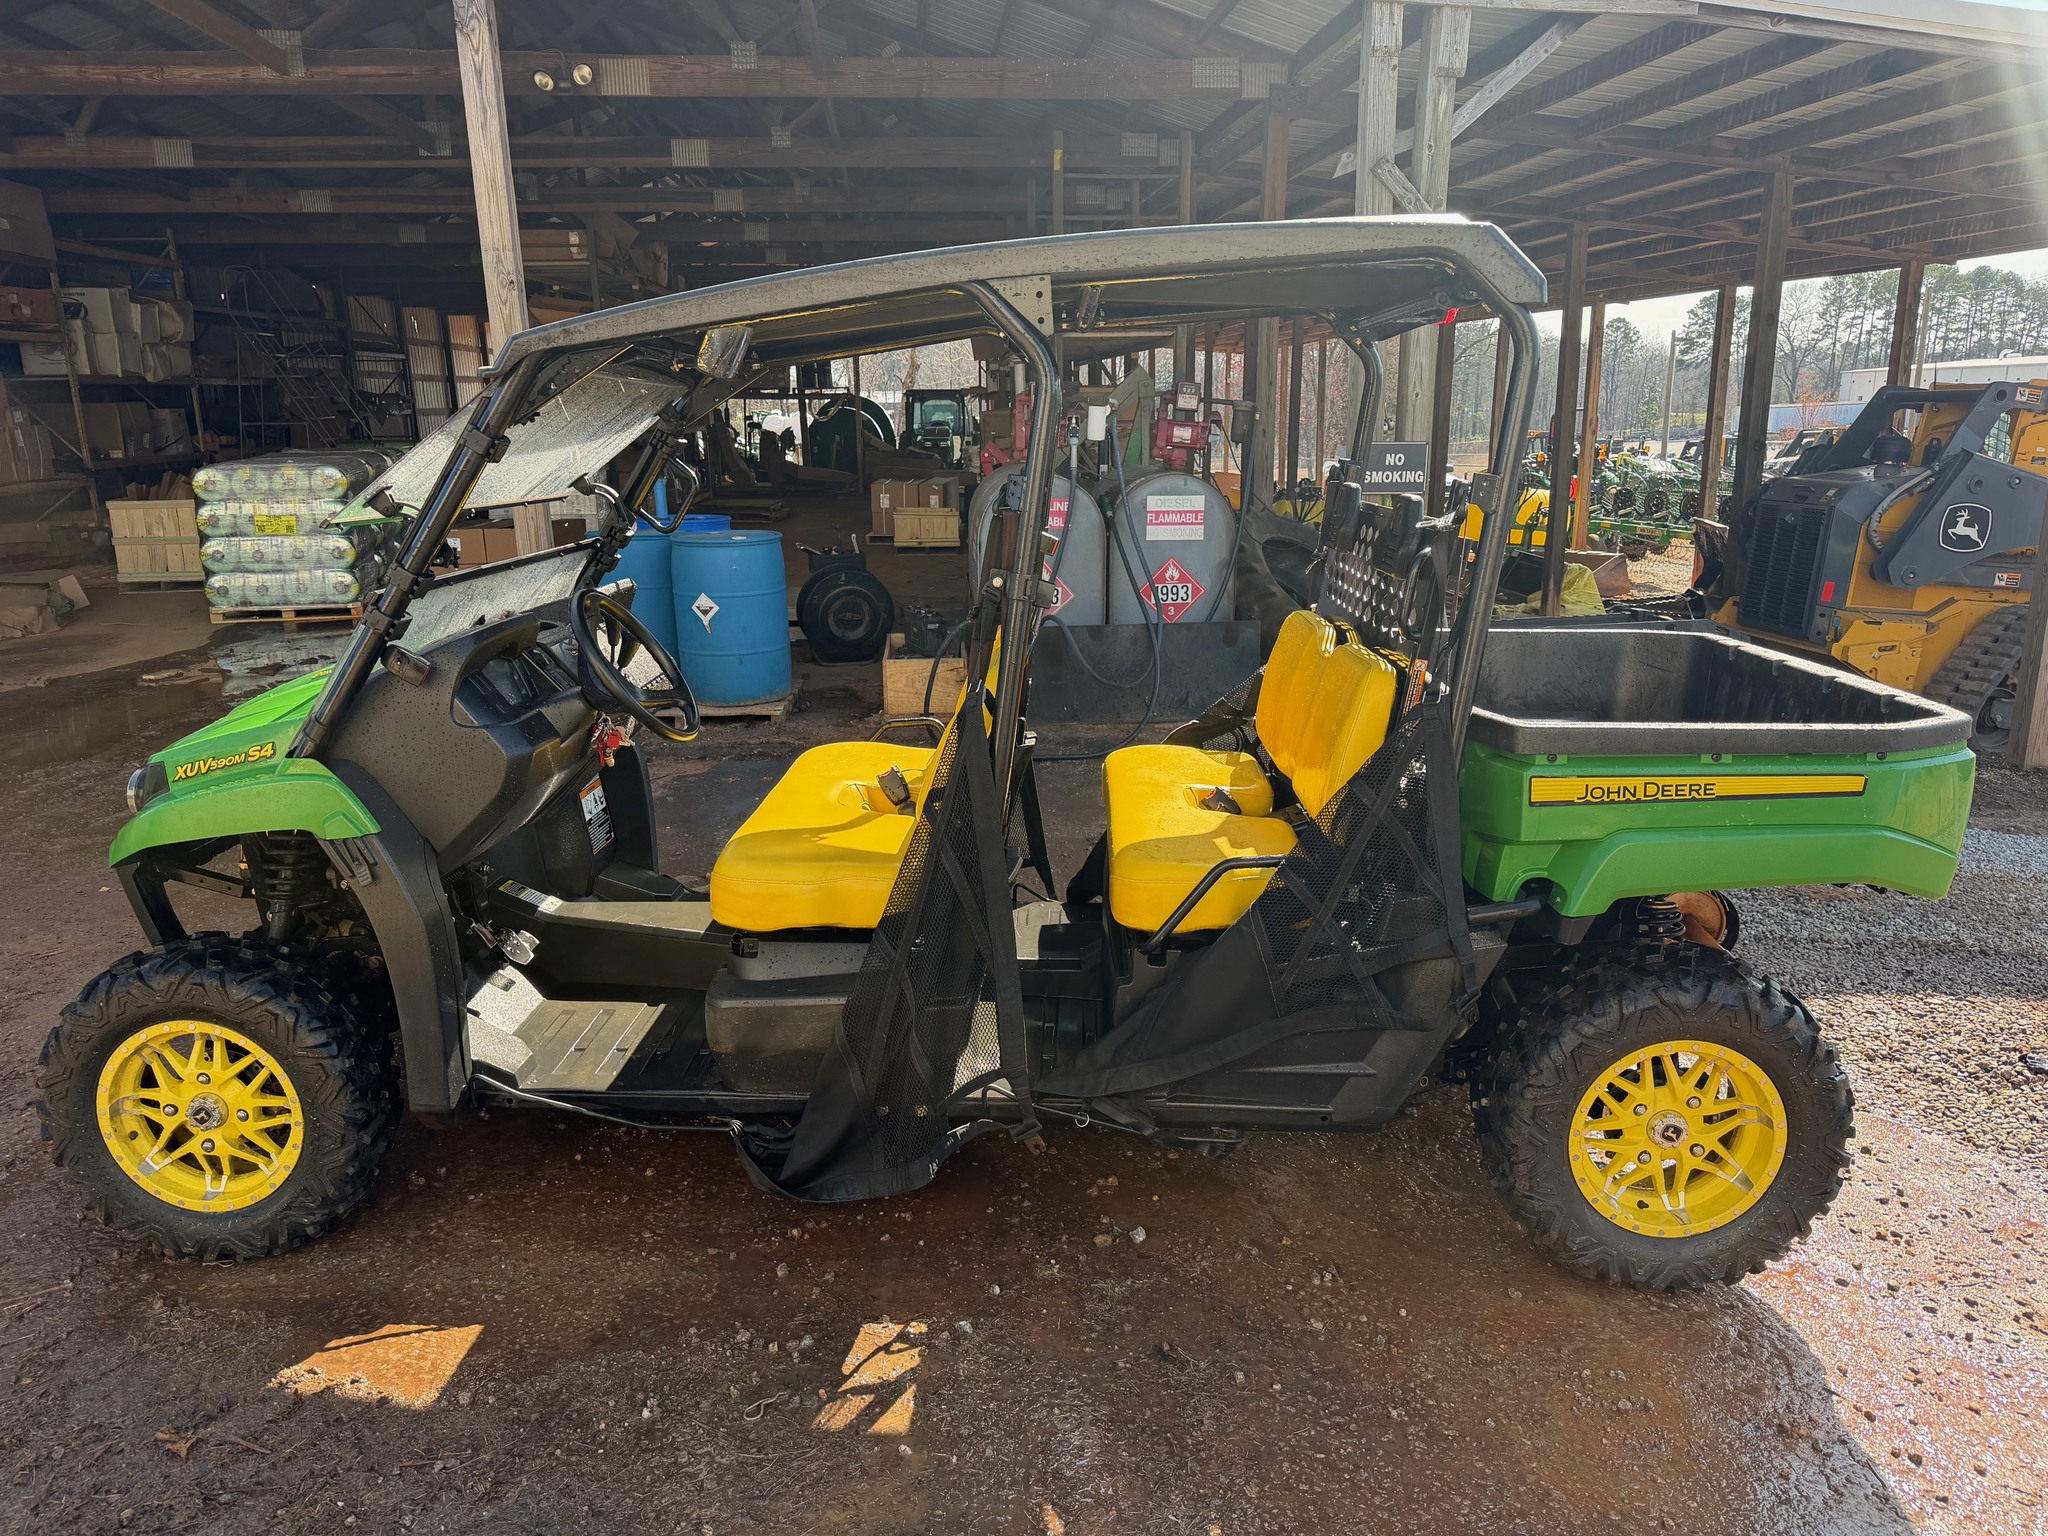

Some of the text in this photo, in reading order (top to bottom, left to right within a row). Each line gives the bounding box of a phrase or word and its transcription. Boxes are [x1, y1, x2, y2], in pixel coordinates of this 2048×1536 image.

[1385, 453, 1405, 466] NO
[1364, 470, 1424, 483] SMOKING
[1155, 498, 1196, 508] DIESEL
[1147, 513, 1204, 524] FLAMMABLE
[1168, 606, 1175, 616] 3
[173, 742, 276, 781] XUV590M S4
[1576, 782, 1717, 801] JOHN DEERE
